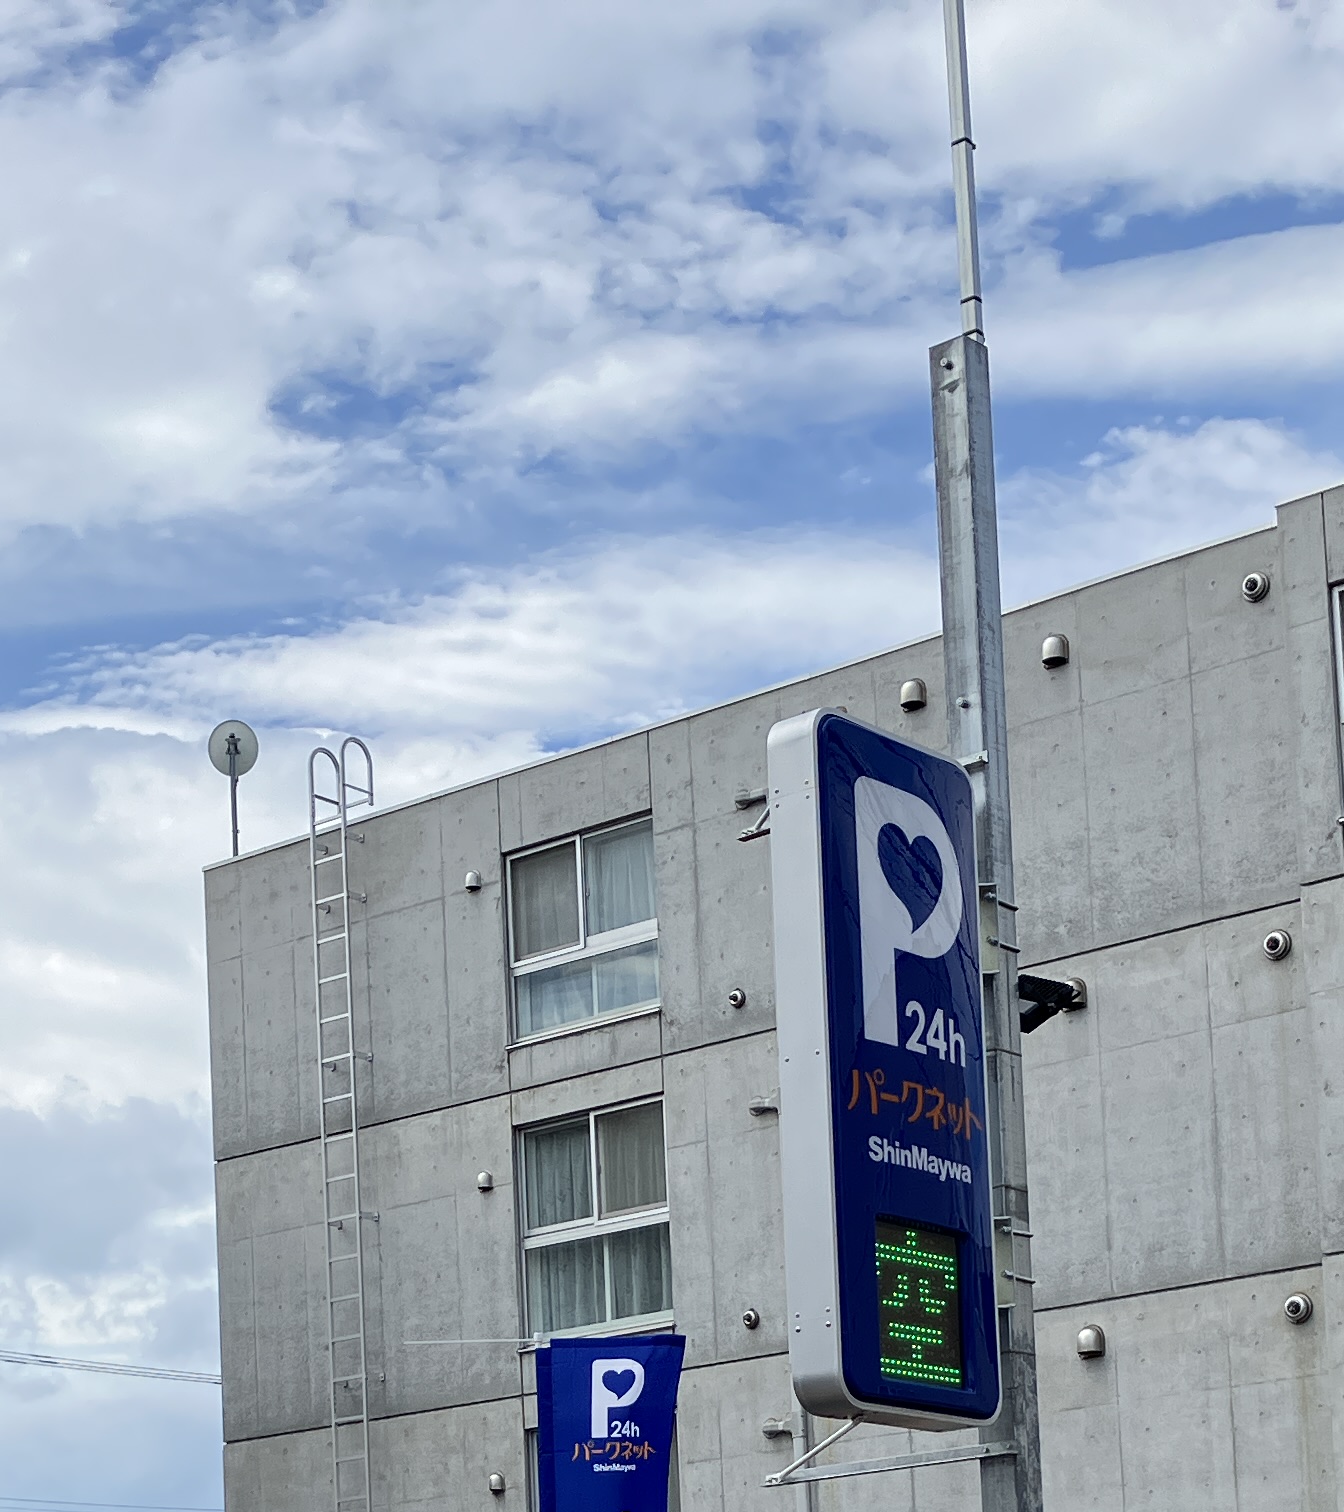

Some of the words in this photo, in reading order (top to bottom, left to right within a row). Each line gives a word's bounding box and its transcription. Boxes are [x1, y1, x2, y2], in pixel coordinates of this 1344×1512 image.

[905, 1000, 967, 1068] 24h
[847, 1068, 984, 1141] パークネット
[868, 1135, 973, 1185] ShinMaywa
[610, 1420, 640, 1438] 24h
[571, 1441, 656, 1462] パークネット
[593, 1462, 636, 1473] ShinMaywa
